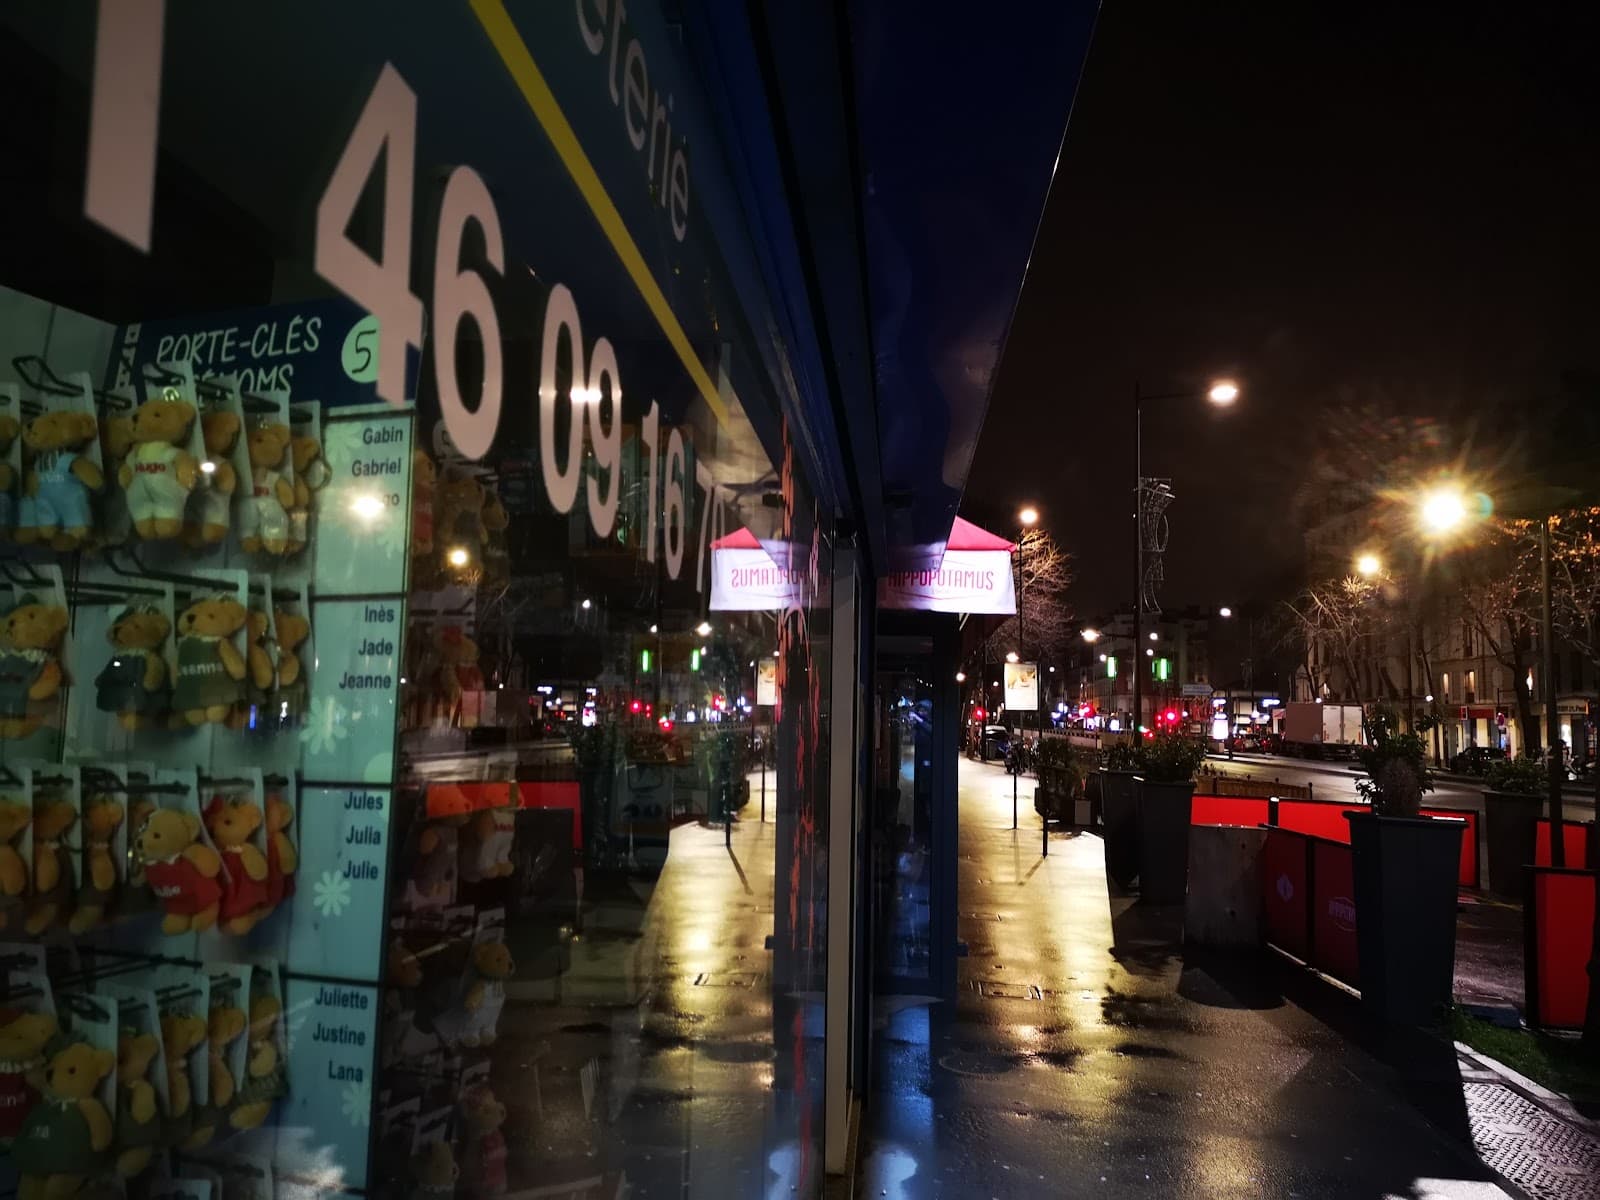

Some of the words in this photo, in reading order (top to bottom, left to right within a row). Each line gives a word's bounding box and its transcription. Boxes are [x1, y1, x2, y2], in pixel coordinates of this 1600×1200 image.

[156, 314, 323, 366] PORTE-CLÉS
[363, 426, 404, 445] Gabin
[539, 282, 622, 540] 09
[642, 397, 685, 581] 16
[352, 457, 402, 477] Gabriel
[364, 604, 395, 623] Inès
[358, 638, 394, 656] Jade
[338, 671, 392, 690] Jeanne
[344, 791, 384, 811] Jules
[346, 826, 381, 846] Julia
[343, 860, 379, 880] Julie
[315, 986, 369, 1010] Juliette
[312, 1023, 366, 1046] Justine
[328, 1060, 364, 1082] Lana
